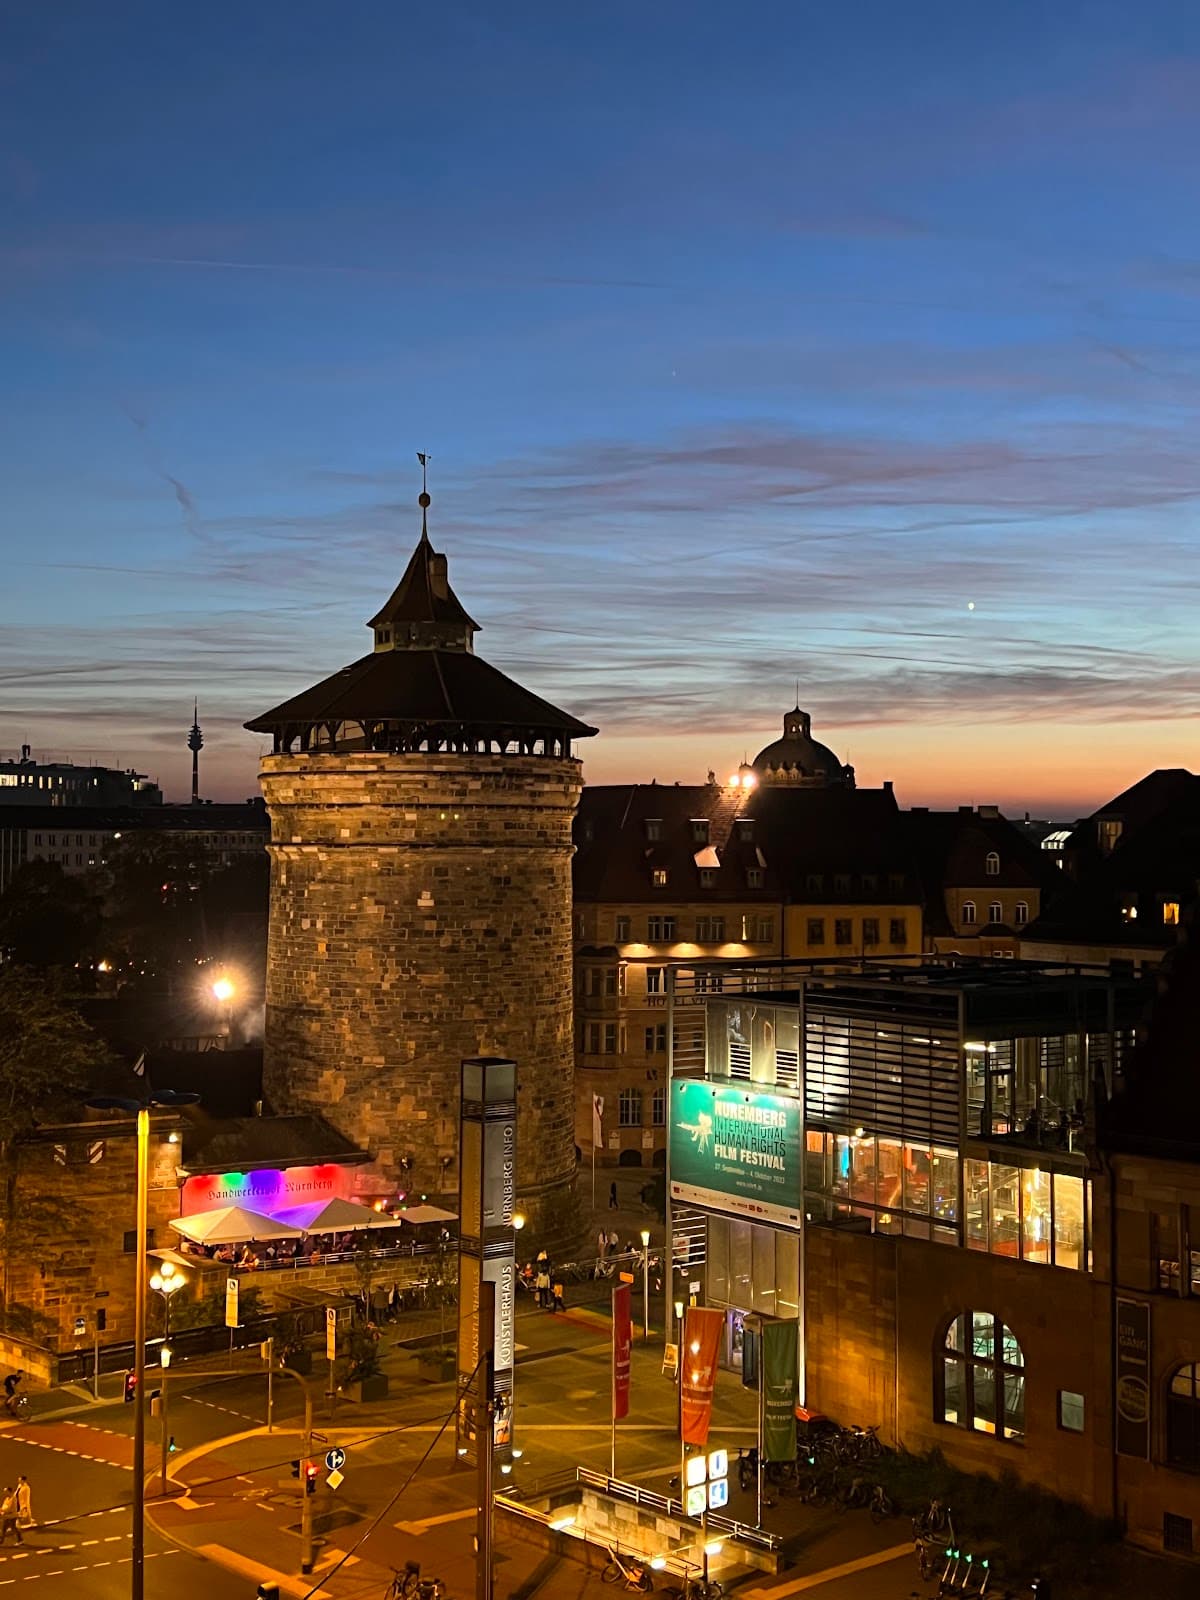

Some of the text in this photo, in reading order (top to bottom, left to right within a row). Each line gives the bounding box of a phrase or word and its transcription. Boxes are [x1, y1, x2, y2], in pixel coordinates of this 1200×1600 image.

[714, 1100, 787, 1127] NUREMBERG
[503, 1125, 513, 1157] INFO
[714, 1117, 785, 1142] INTERNATIONAL
[714, 1132, 786, 1157] HUMAN RIGHTS
[714, 1144, 786, 1171] FILM FESTIVAL
